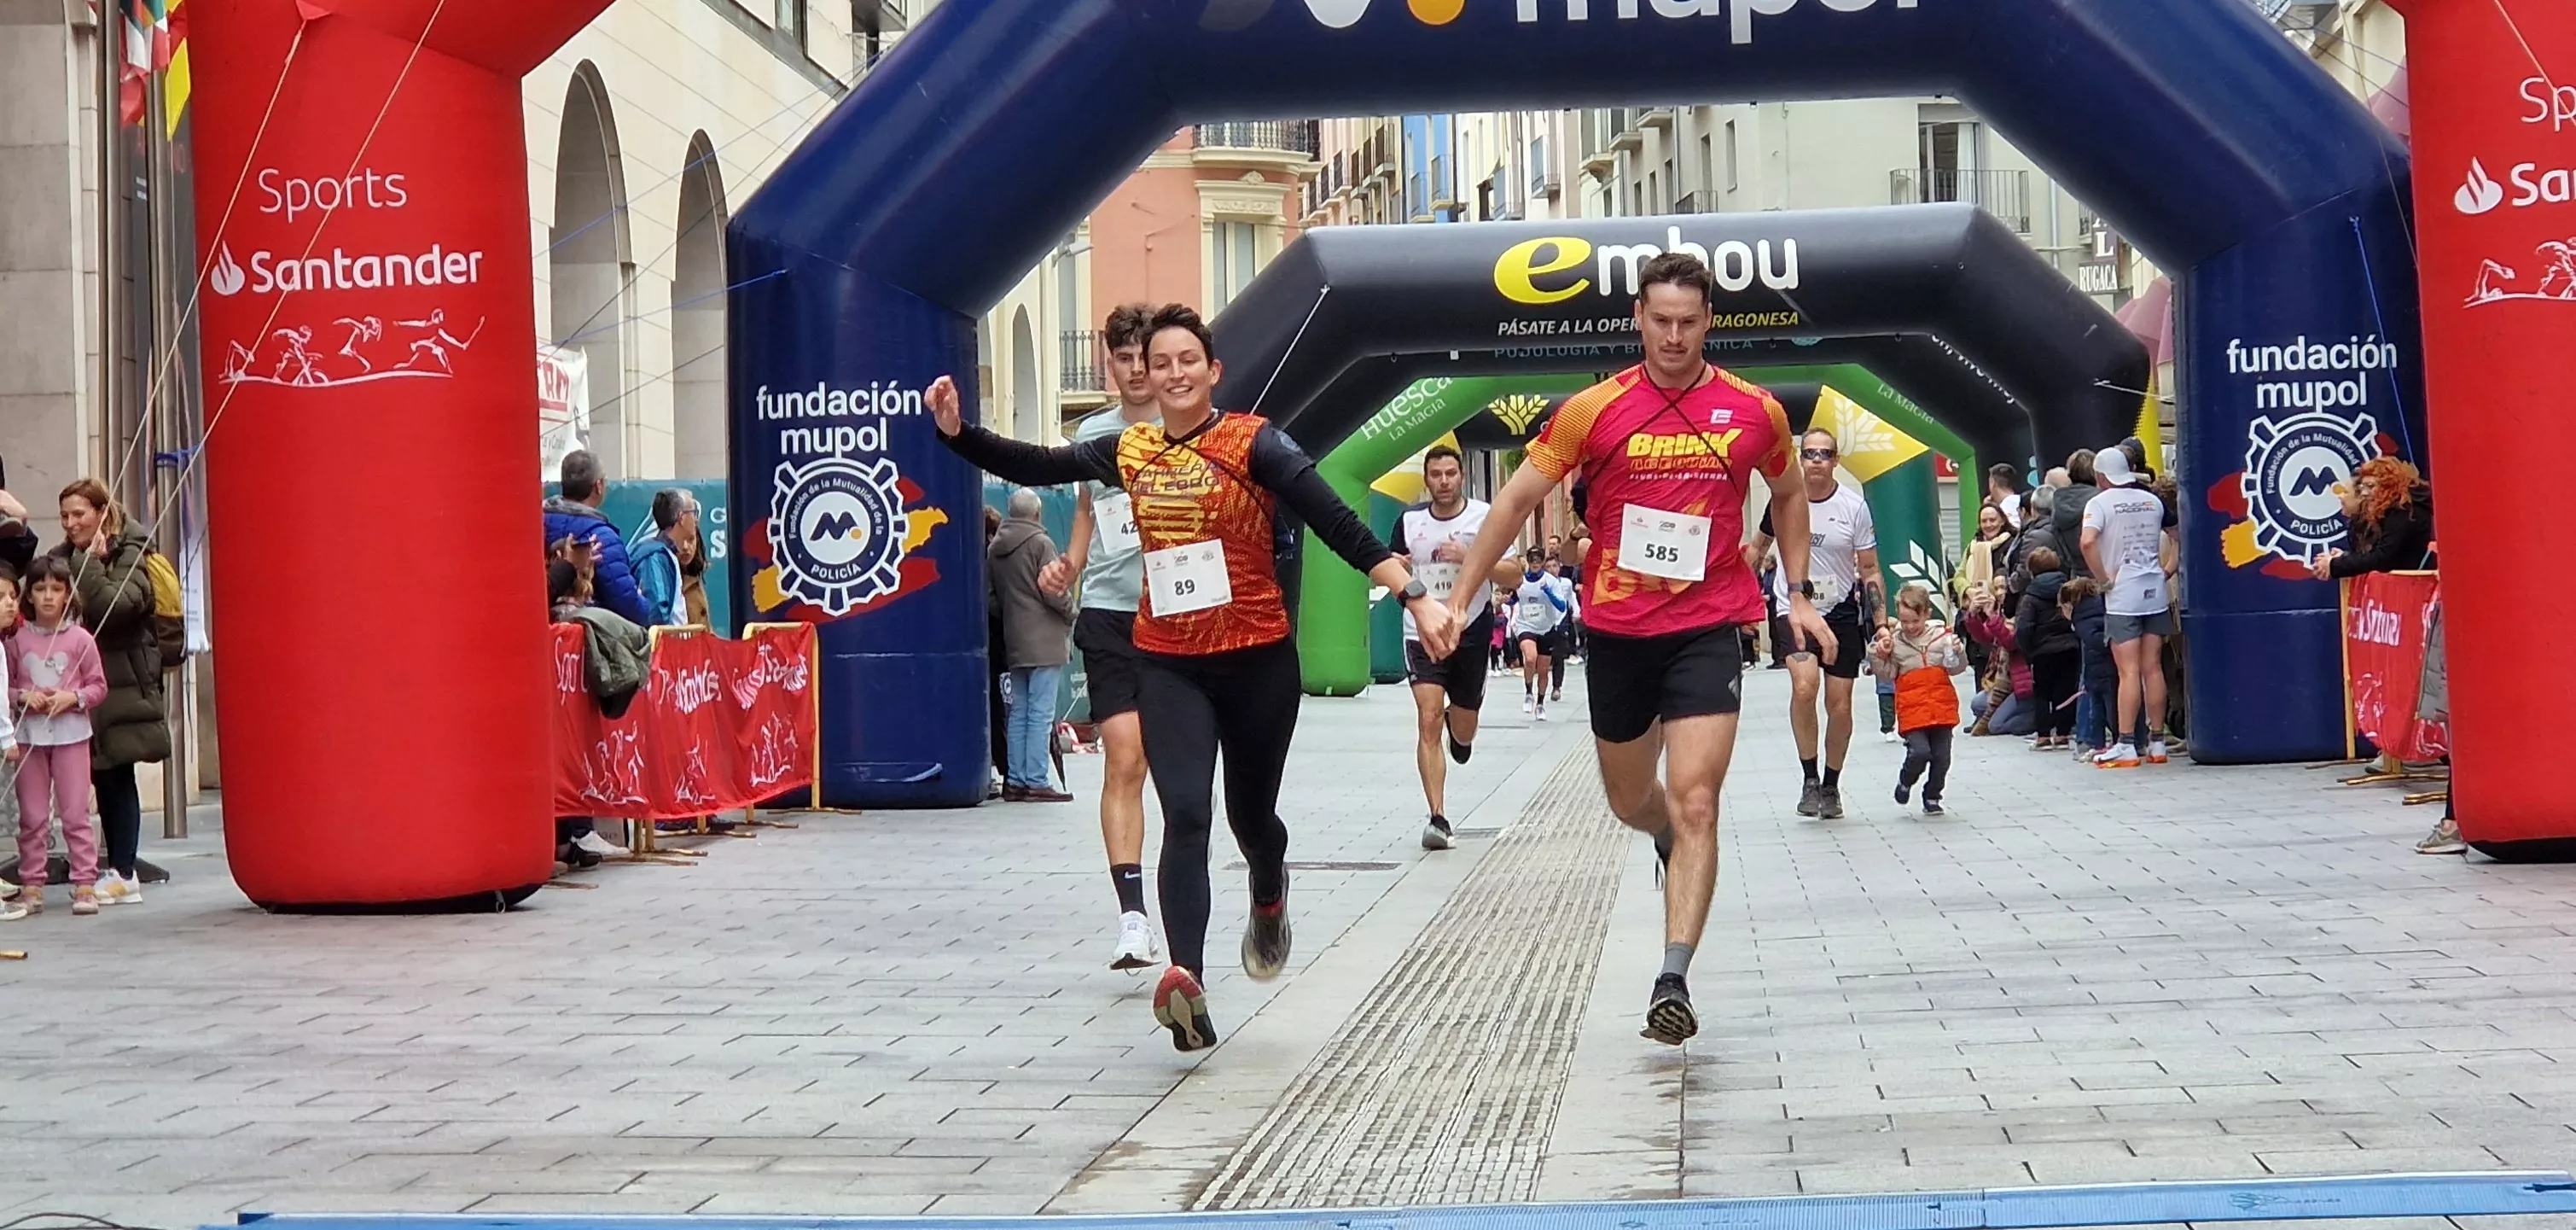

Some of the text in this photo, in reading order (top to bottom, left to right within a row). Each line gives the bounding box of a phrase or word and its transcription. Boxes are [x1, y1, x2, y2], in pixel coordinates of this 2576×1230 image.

[259, 167, 408, 223] Sports
[2510, 161, 2576, 207] Sa
[251, 243, 483, 293] Santander
[2079, 264, 2118, 292] RUGACA
[1497, 311, 1799, 336] PÁSATE A LA OPER RAGONESA
[2226, 334, 2398, 373] fundación
[756, 380, 922, 420] fundación
[2257, 371, 2367, 413] mupol
[781, 417, 887, 458] mupol
[1388, 426, 1406, 441] La
[1627, 428, 1743, 458] BRINK
[2266, 433, 2360, 494] Fundación de la Mutualidad
[789, 478, 885, 539] Fundación de la Mutualidad de la
[1121, 521, 1138, 535] 42
[2290, 518, 2343, 535] POLICÍA
[1645, 543, 1678, 563] 585
[811, 563, 862, 580] POLICÍA
[1174, 579, 1195, 596] 89
[1809, 592, 1825, 601] 08
